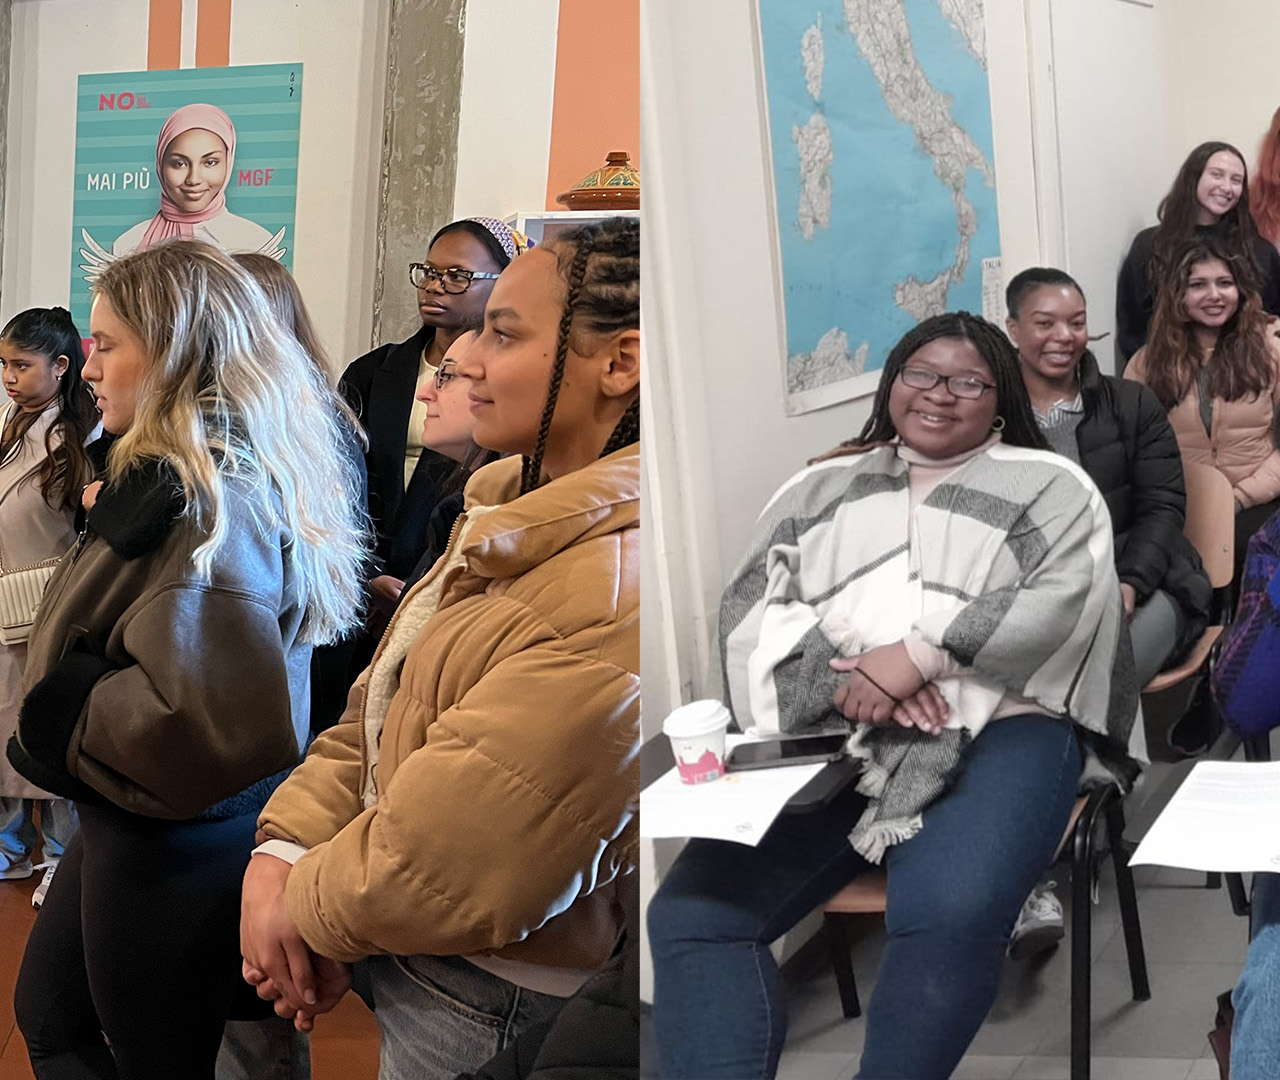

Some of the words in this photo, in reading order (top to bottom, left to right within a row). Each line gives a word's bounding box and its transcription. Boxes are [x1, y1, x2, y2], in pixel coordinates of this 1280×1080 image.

[99, 91, 135, 111] NO
[87, 173, 115, 191] MAI
[123, 167, 150, 190] PIÙ
[238, 168, 275, 187] MGF
